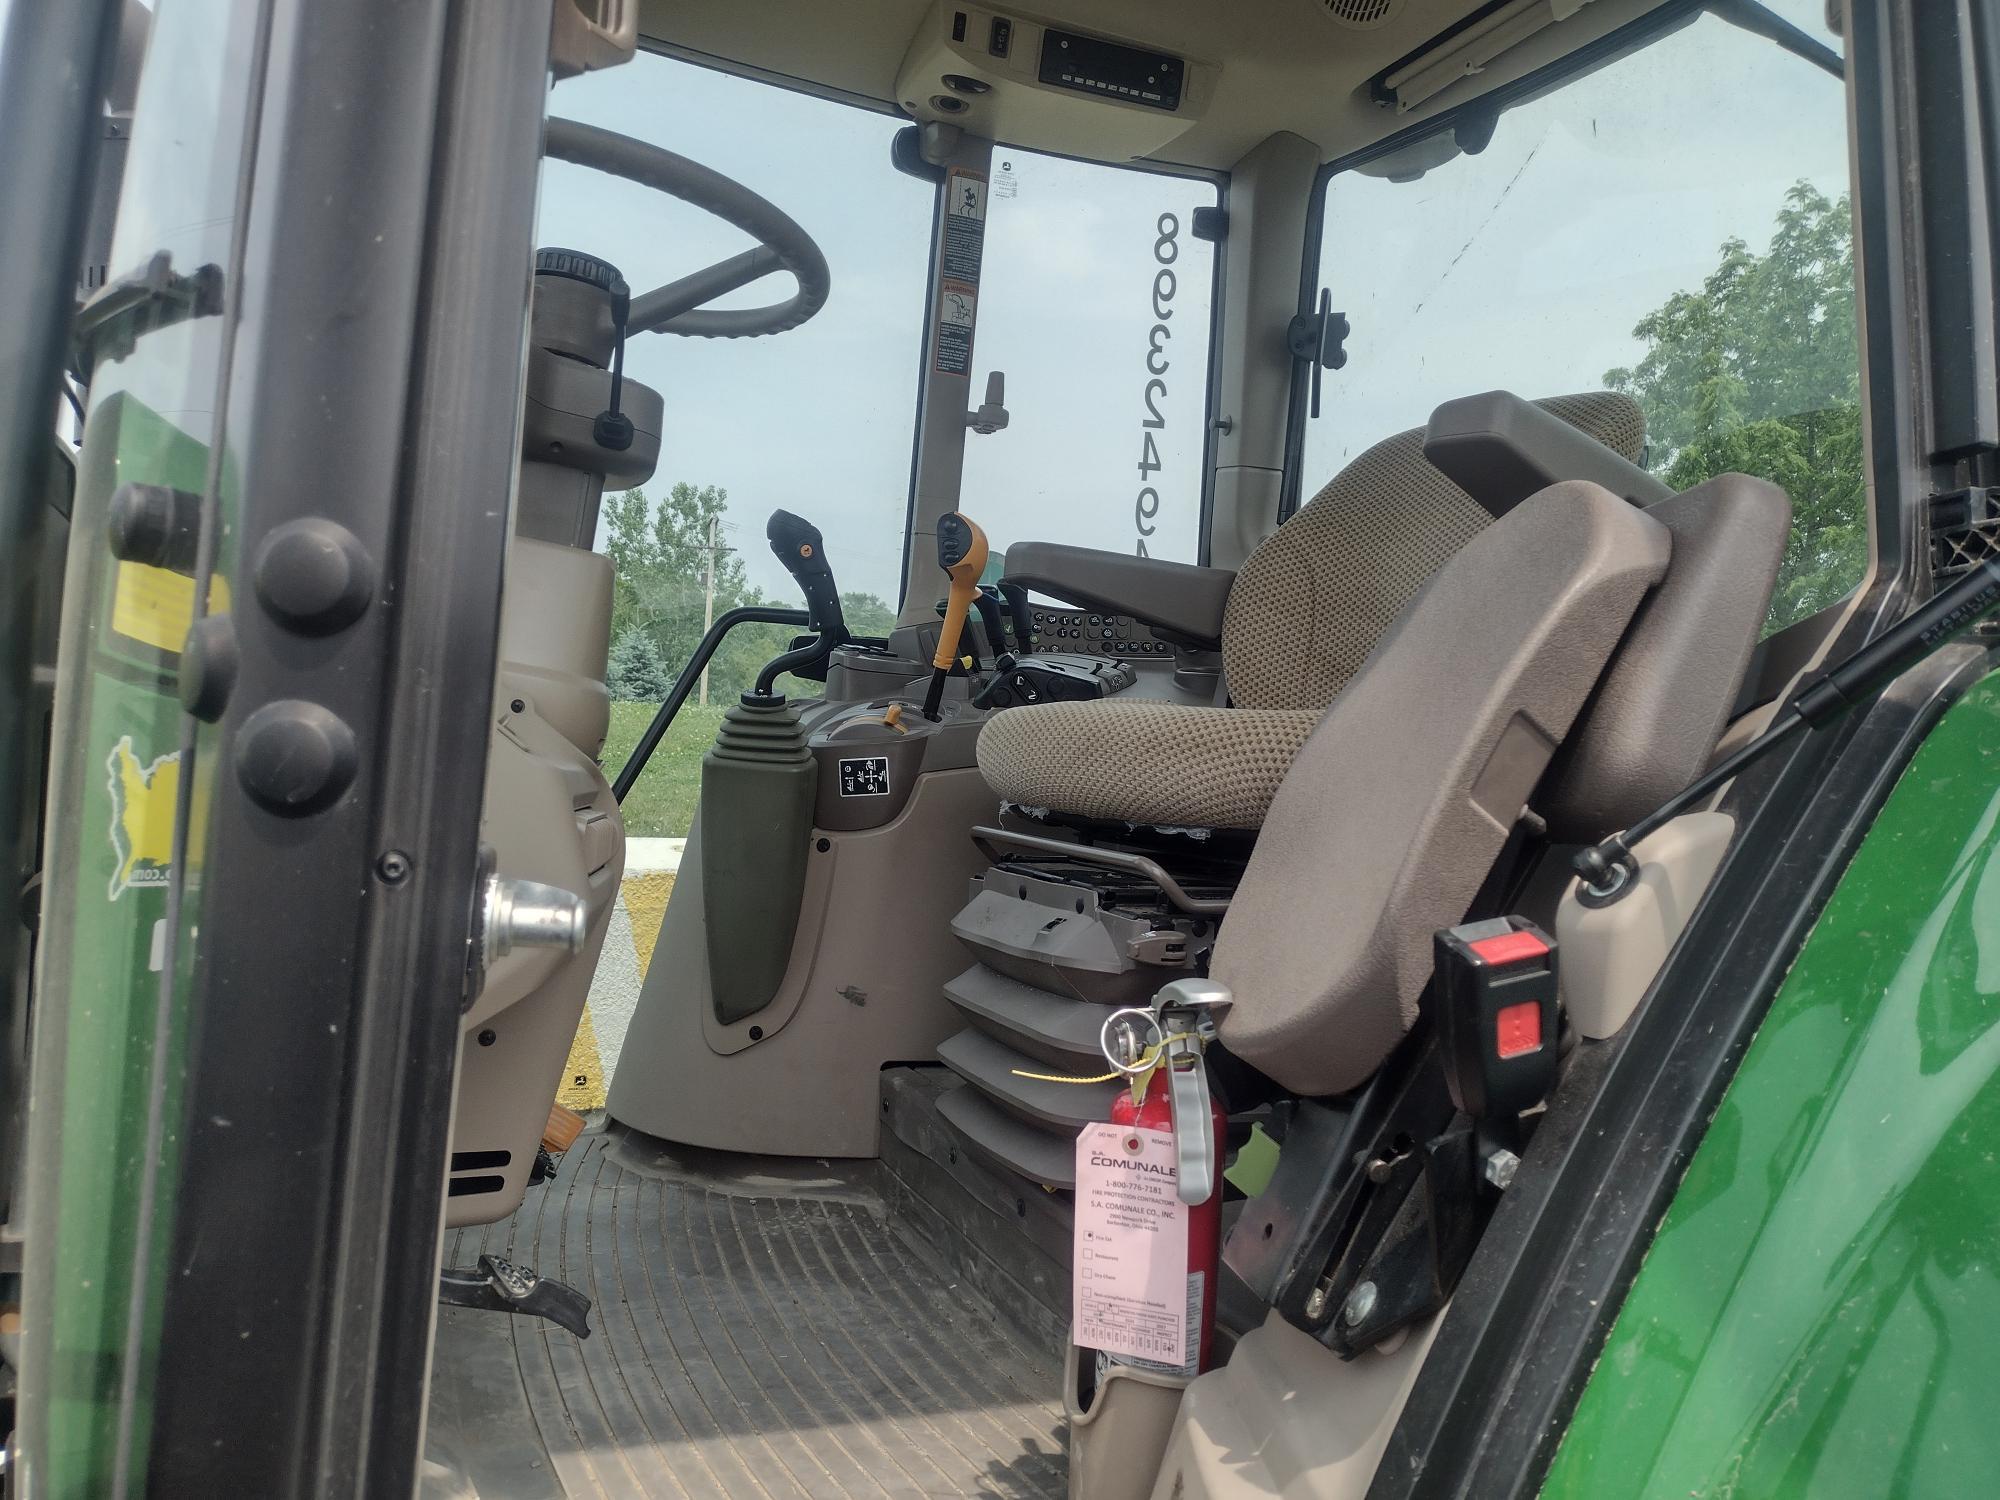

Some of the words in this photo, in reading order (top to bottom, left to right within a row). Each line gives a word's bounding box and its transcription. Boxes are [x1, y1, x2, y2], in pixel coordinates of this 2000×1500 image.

[1151, 1138, 1172, 1148] REMOVE
[1091, 1157, 1177, 1177] COMUNALE
[1106, 1179, 1162, 1195] 1-800-776-7181
[1104, 1191, 1136, 1200] PROTECTION
[1137, 1195, 1175, 1207] CONTRACTORS
[1091, 1200, 1104, 1209] S.A.
[1105, 1202, 1146, 1215] COMUNALE
[1162, 1211, 1175, 1220] INC.
